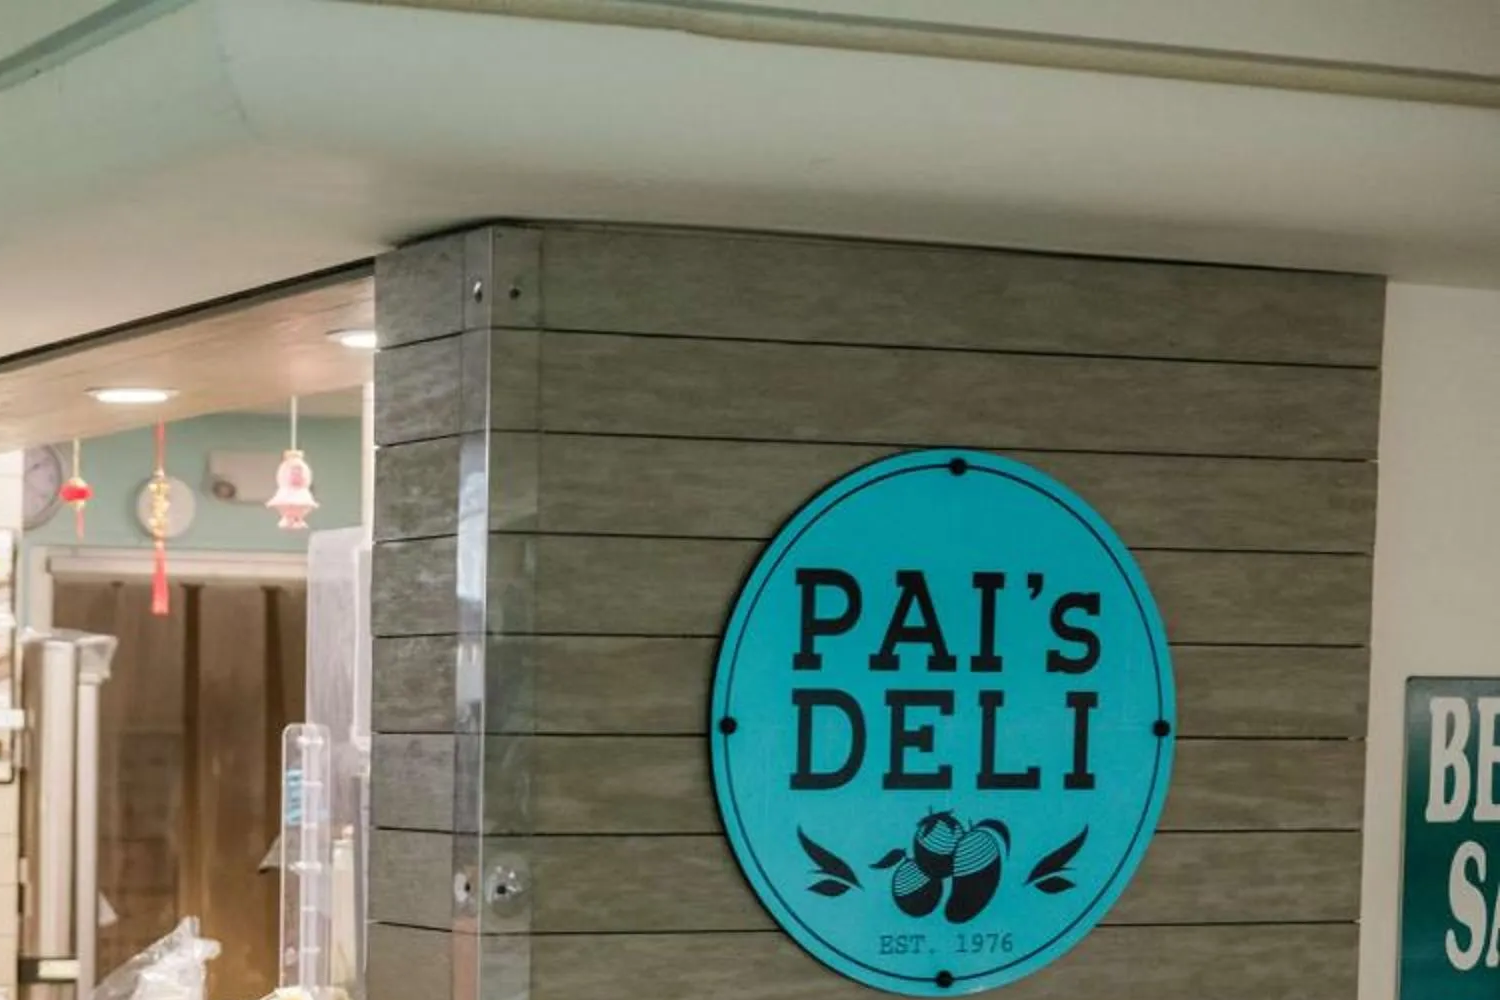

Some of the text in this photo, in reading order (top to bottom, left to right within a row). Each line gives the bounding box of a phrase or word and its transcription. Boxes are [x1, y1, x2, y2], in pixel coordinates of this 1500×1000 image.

[791, 567, 1102, 675] PAI's
[789, 687, 1099, 791] DELI
[879, 931, 1014, 956] EST. 1976
